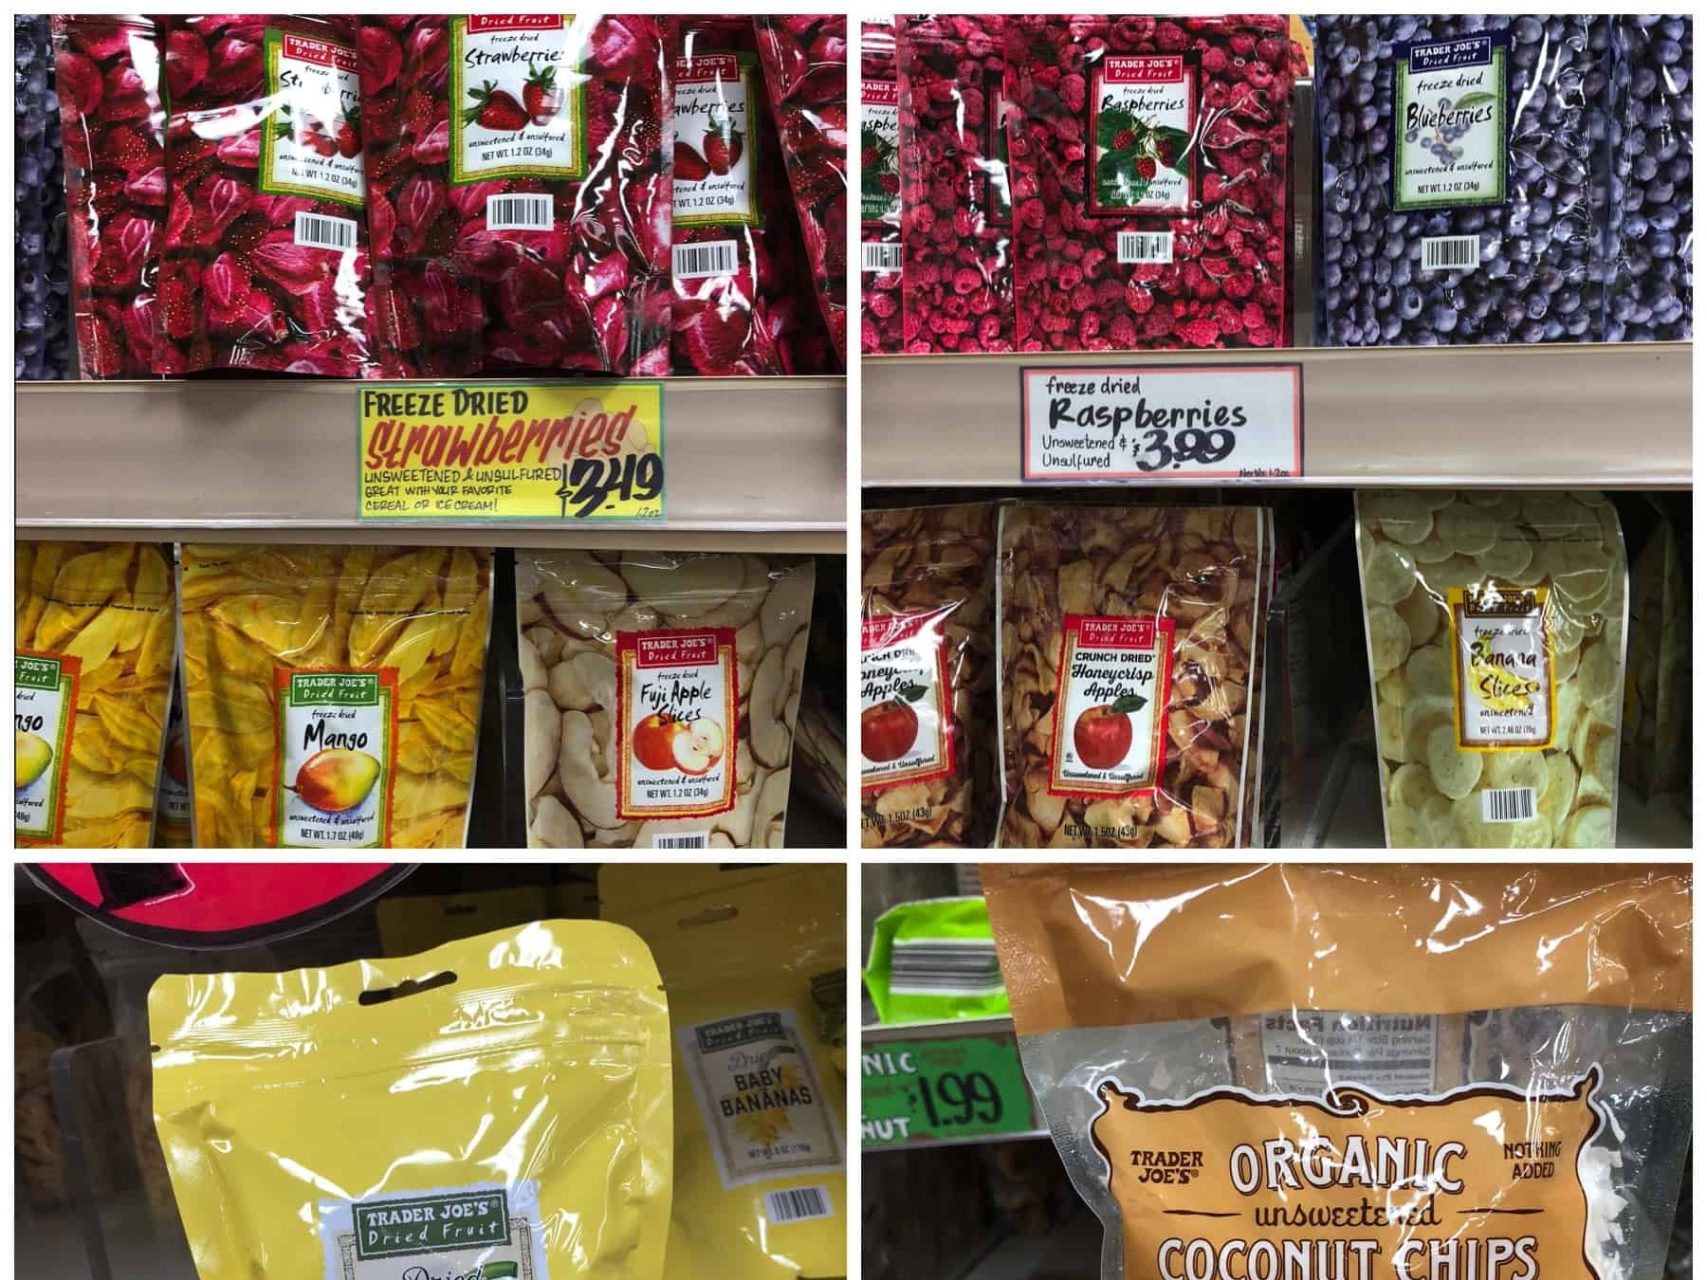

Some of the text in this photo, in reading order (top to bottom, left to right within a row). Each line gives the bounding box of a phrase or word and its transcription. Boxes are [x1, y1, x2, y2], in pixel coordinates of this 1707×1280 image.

[481, 15, 550, 26] Dried Fruit
[491, 33, 539, 44] freeze dried
[465, 46, 564, 69] Strawberrie
[1415, 45, 1451, 58] TRADER
[1423, 52, 1478, 66] Dried Fruit
[1110, 60, 1145, 69] TRADER
[1115, 69, 1173, 78] Dried Fruit
[1123, 86, 1164, 96] freeze dried
[1417, 72, 1483, 95] freeze dried
[1102, 94, 1185, 112] Raspberries
[1407, 102, 1493, 130] Blueberries
[482, 151, 494, 161] NET
[512, 148, 522, 157] 1.2
[524, 148, 532, 156] OZ
[1405, 165, 1448, 176] unsweetened
[1457, 160, 1493, 172] unsulfured
[1046, 376, 1141, 396] freeze dried
[364, 389, 529, 418] FREEZE DRIED
[1049, 398, 1247, 437] Raspberries
[1043, 435, 1114, 450] Unsweetened
[1043, 453, 1110, 470] Unsulfured
[365, 468, 460, 483] UNSWEETENED
[476, 468, 560, 482] UNSULFURED
[365, 484, 512, 498] GREAT WITH YOUR FAVORITE
[366, 499, 409, 511] CEREAL
[414, 499, 429, 510] OR
[436, 499, 453, 510] ICE
[1085, 623, 1118, 633] TRADER
[642, 639, 678, 650] TRADER
[648, 650, 707, 661] Dried Fruit
[1076, 652, 1117, 663] CRUNCH
[298, 678, 336, 688] TRADER
[1072, 664, 1154, 686] Honeycrisp
[641, 680, 712, 710] Fuji Apple
[1084, 682, 1135, 702] Apples
[657, 703, 701, 727] Slices
[303, 719, 368, 751] Mango
[735, 1067, 783, 1092] BABY
[721, 1087, 812, 1117] BANANAS
[1503, 1141, 1562, 1159] NOTHING
[1131, 1151, 1204, 1168] TRADER
[1229, 1136, 1467, 1196] ORGANIC
[1512, 1162, 1555, 1179] ADDED
[367, 1206, 435, 1227] TRADER
[1256, 1195, 1442, 1227] unsweeteed
[369, 1221, 499, 1246] Dried Fruit
